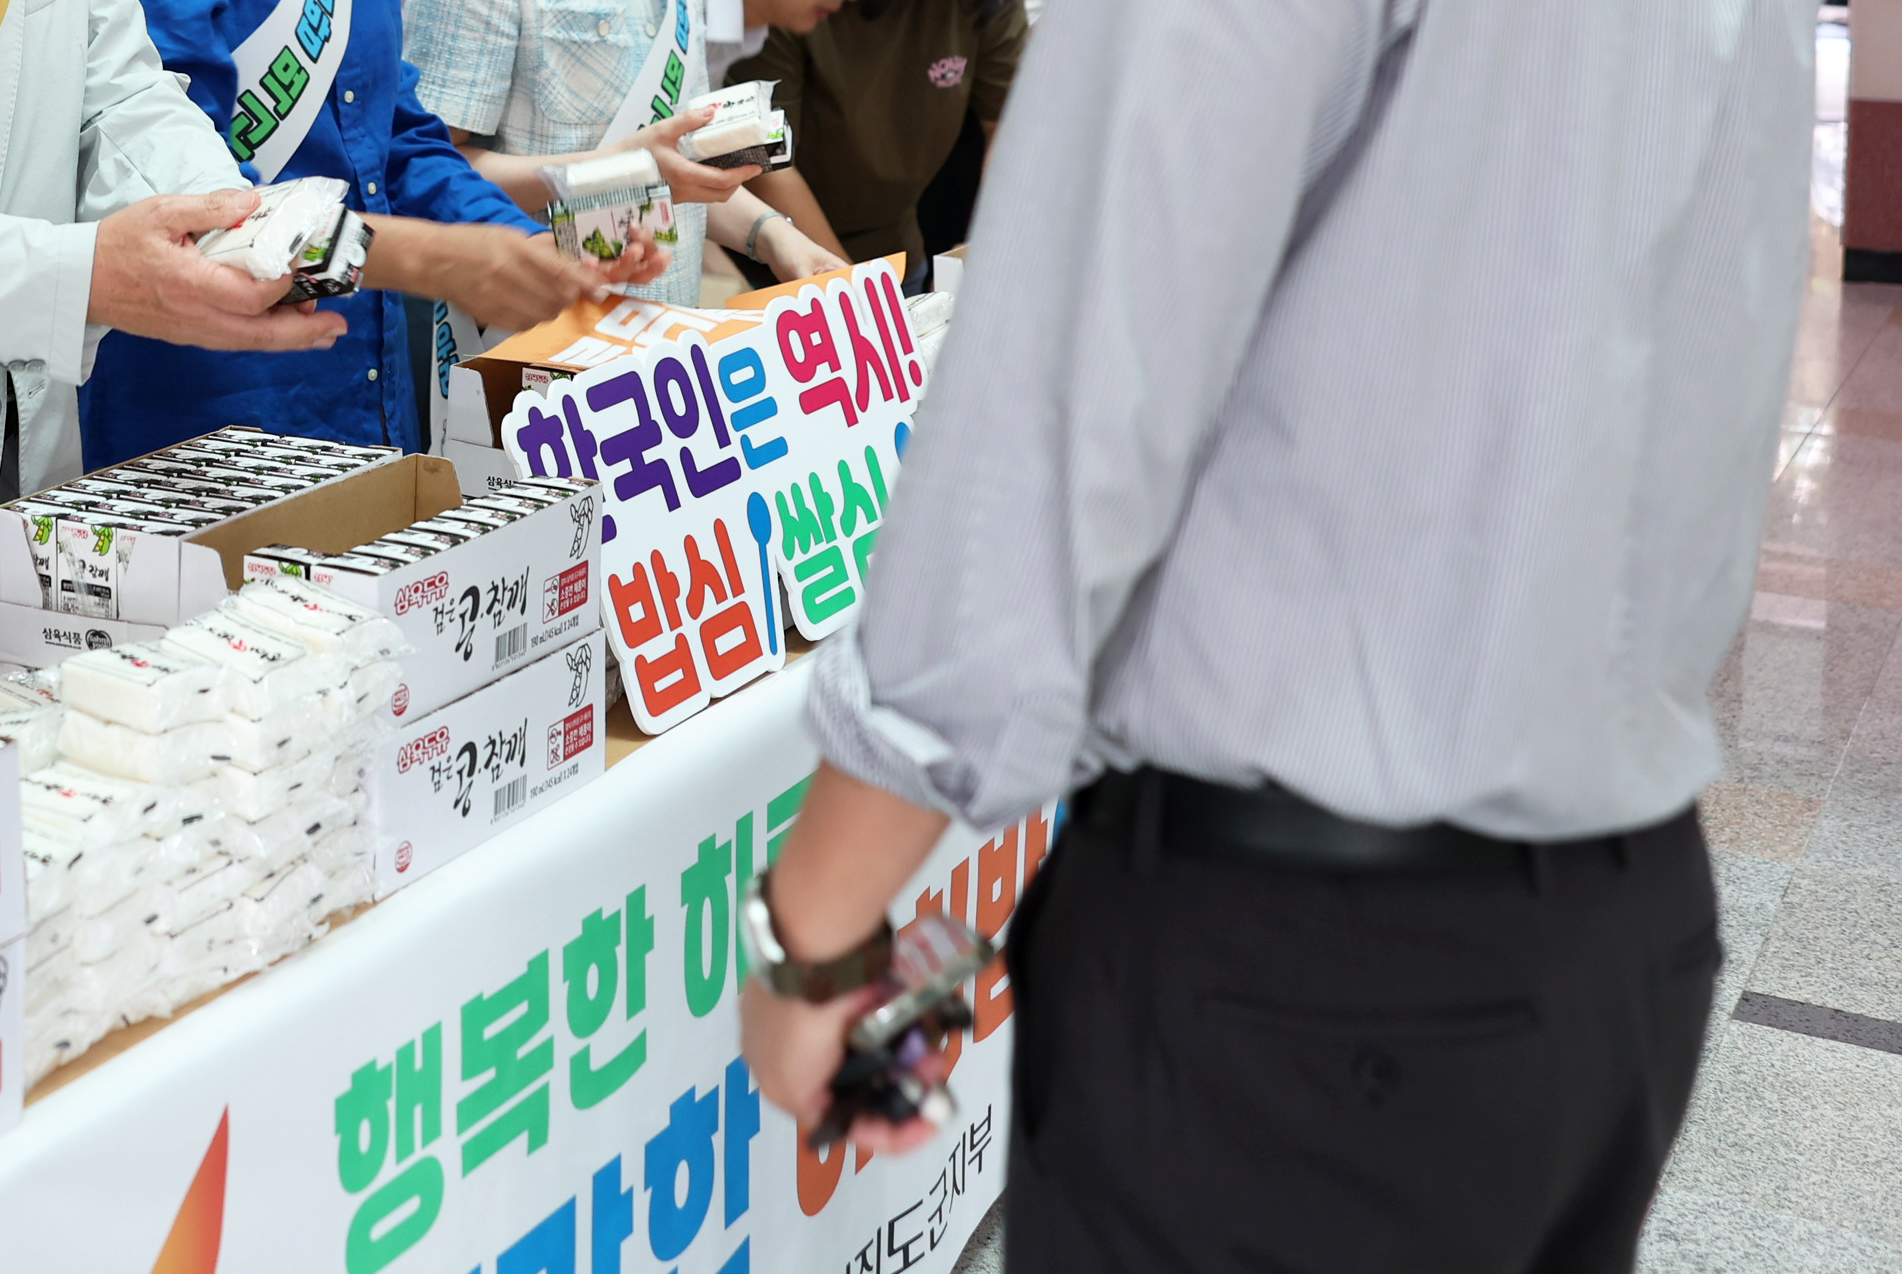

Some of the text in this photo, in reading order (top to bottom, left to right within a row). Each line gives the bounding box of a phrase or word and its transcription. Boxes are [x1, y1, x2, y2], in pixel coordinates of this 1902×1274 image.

[776, 270, 924, 429] 역시!
[42, 627, 82, 645] 삼육식품
[394, 571, 449, 616] 삼육두유
[607, 518, 764, 718] 밥심
[397, 725, 450, 775] 삼육두유
[335, 884, 654, 1274] 행복한
